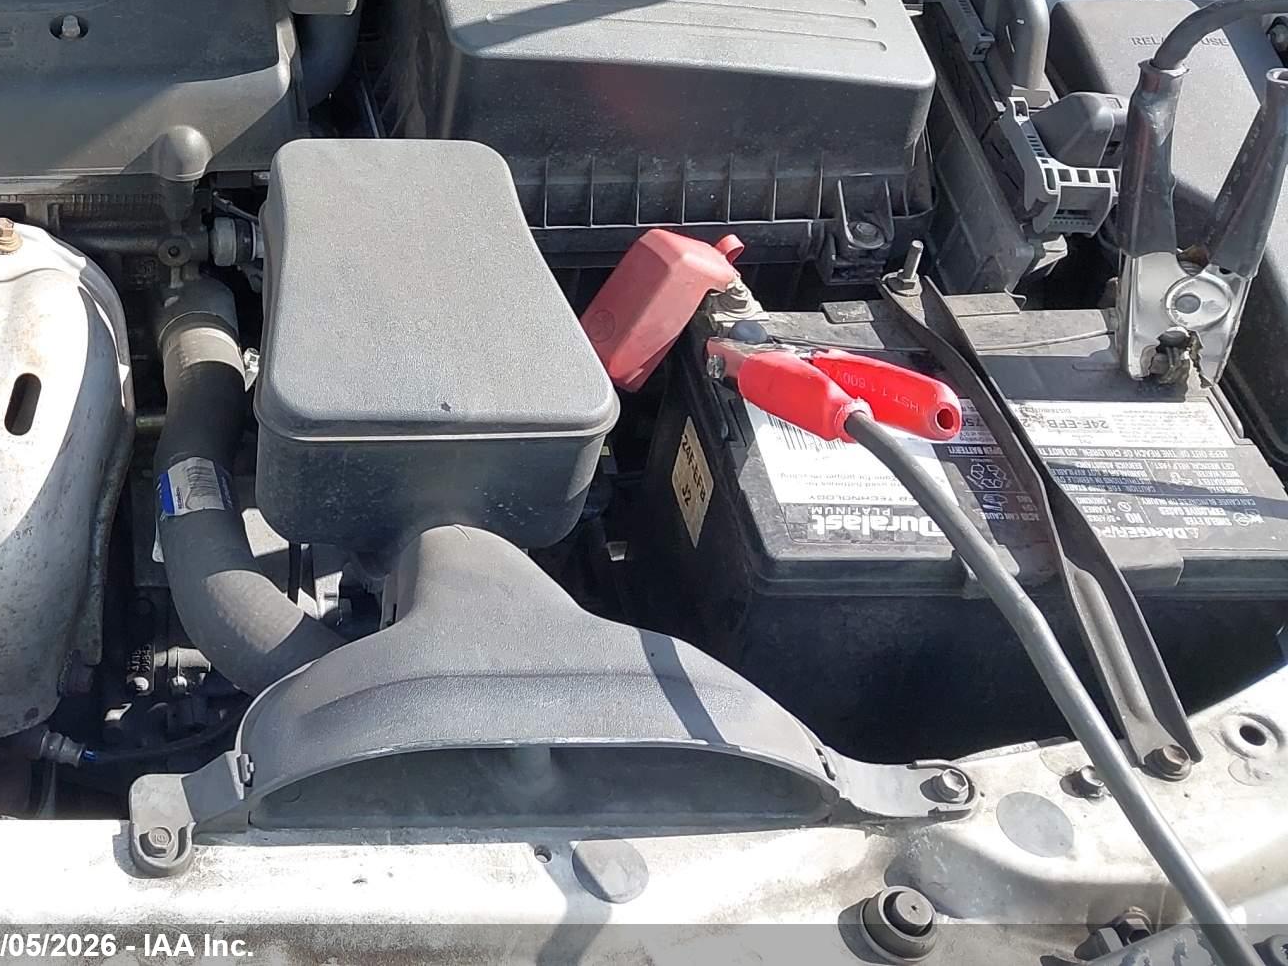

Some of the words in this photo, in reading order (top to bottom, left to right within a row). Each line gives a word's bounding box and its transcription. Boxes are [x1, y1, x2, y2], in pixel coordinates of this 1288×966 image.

[1201, 37, 1230, 47] USE
[1048, 419, 1109, 429] 24F-EFB
[813, 515, 945, 537] Duralast
